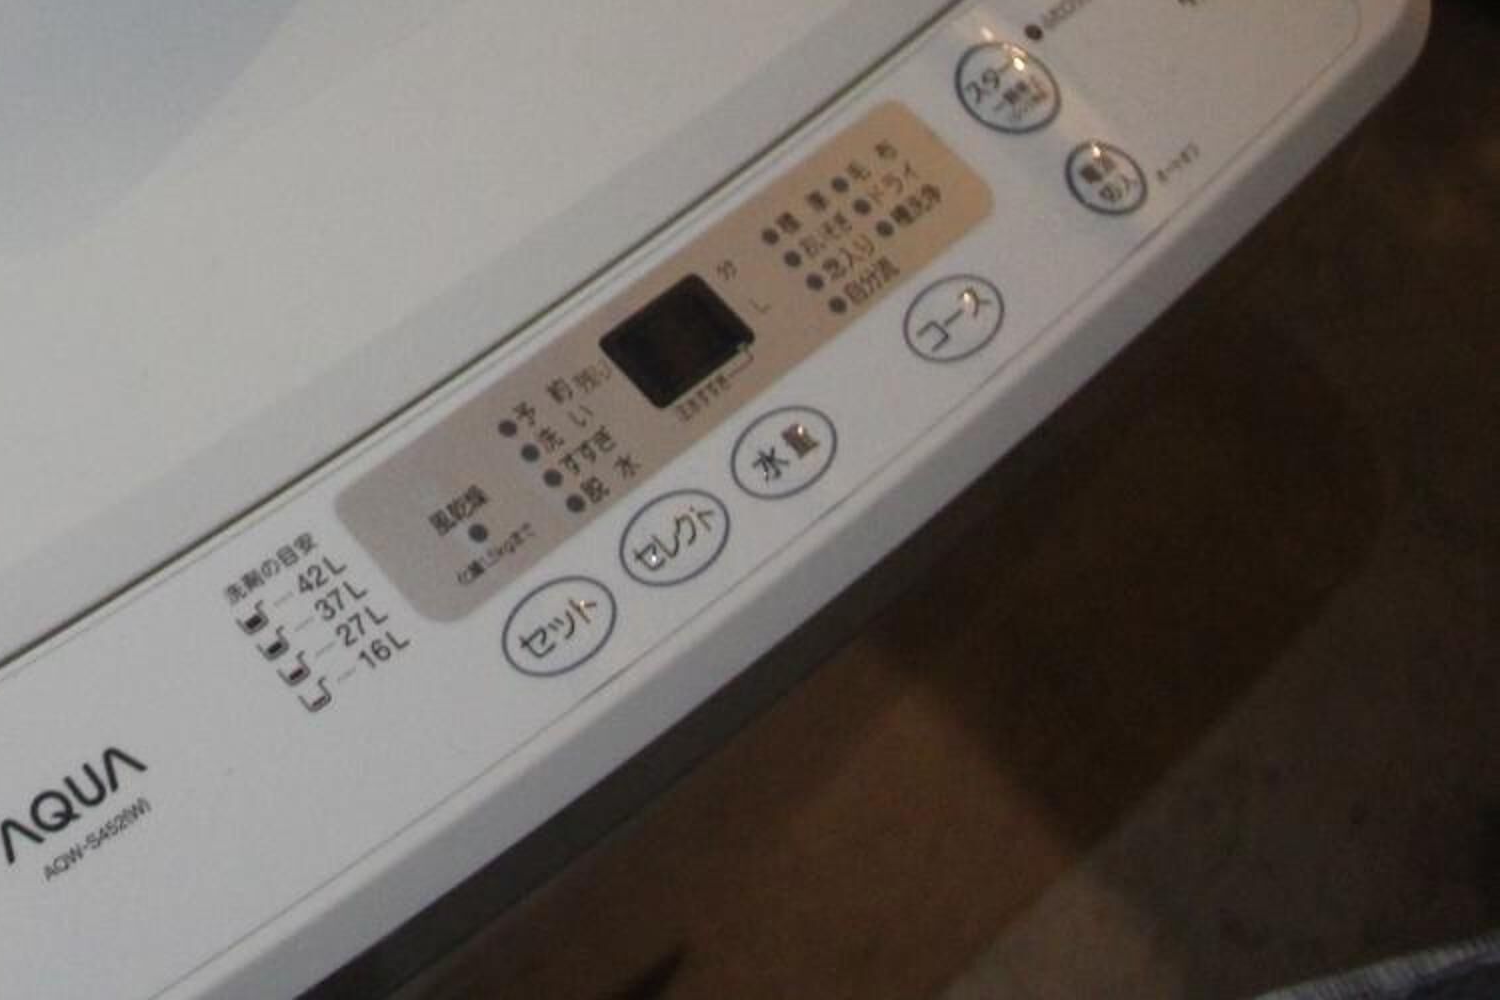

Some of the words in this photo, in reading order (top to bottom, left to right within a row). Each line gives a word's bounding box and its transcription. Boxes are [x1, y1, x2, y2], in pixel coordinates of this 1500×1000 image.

[559, 425, 618, 476] すすぎ
[634, 506, 716, 572] セレクト
[297, 556, 347, 594] 42L
[314, 581, 368, 621] 37L
[336, 606, 389, 647] 27L
[518, 597, 598, 660] セット
[358, 631, 410, 669] 16L
[0, 746, 148, 865] AQUA
